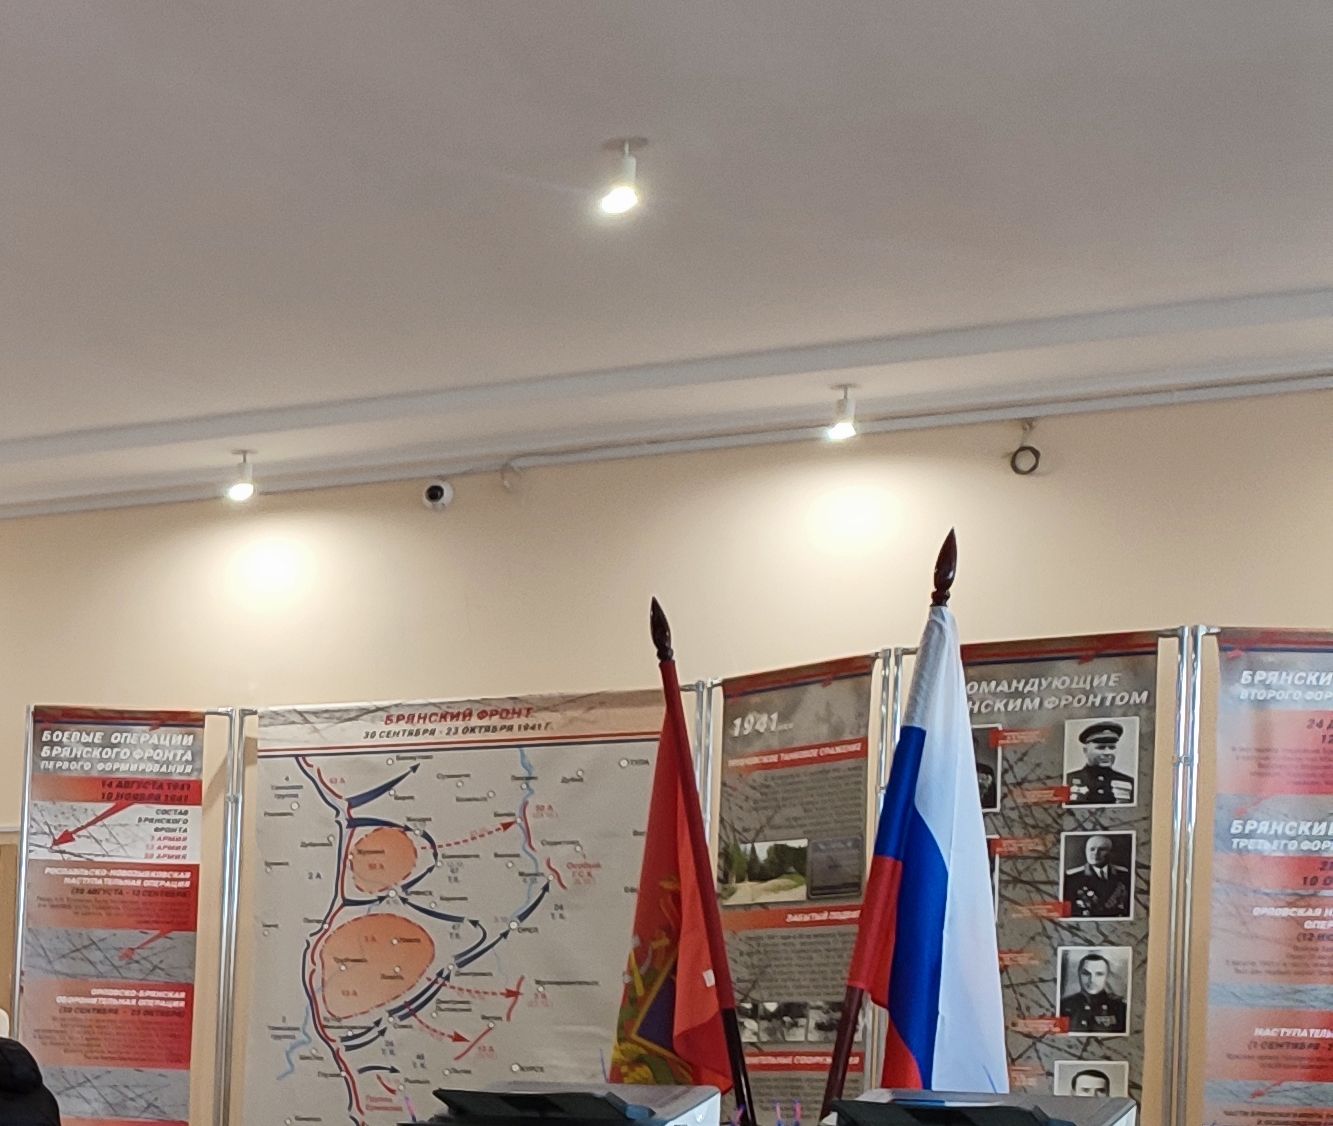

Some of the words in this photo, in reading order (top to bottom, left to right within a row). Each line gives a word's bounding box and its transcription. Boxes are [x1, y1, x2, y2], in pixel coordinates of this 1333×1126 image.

[967, 673, 1122, 695] ОМАНДУЮЩИЕ
[968, 697, 1041, 714] НСКИМ
[1042, 690, 1149, 710] ФРОНТОМ
[1239, 689, 1302, 701] ВТОРОГО
[384, 708, 473, 726] БРЯНСКИЙ
[476, 706, 534, 721] ФРОНТ
[41, 730, 105, 744] БОЕВЫЕ
[110, 732, 194, 747] ОПЕРАЦИИ
[363, 730, 377, 740] 30
[378, 727, 437, 739] СЕНТЯБРЯ
[445, 726, 460, 736] 23
[461, 723, 515, 735] ОКТЯБРЯ
[40, 746, 131, 760] БРЯНСКОГО
[132, 748, 193, 762] ФРОНТА
[40, 761, 92, 771] ПЕРВОГО
[96, 761, 193, 774] ФОРМИРОВАНИЯ
